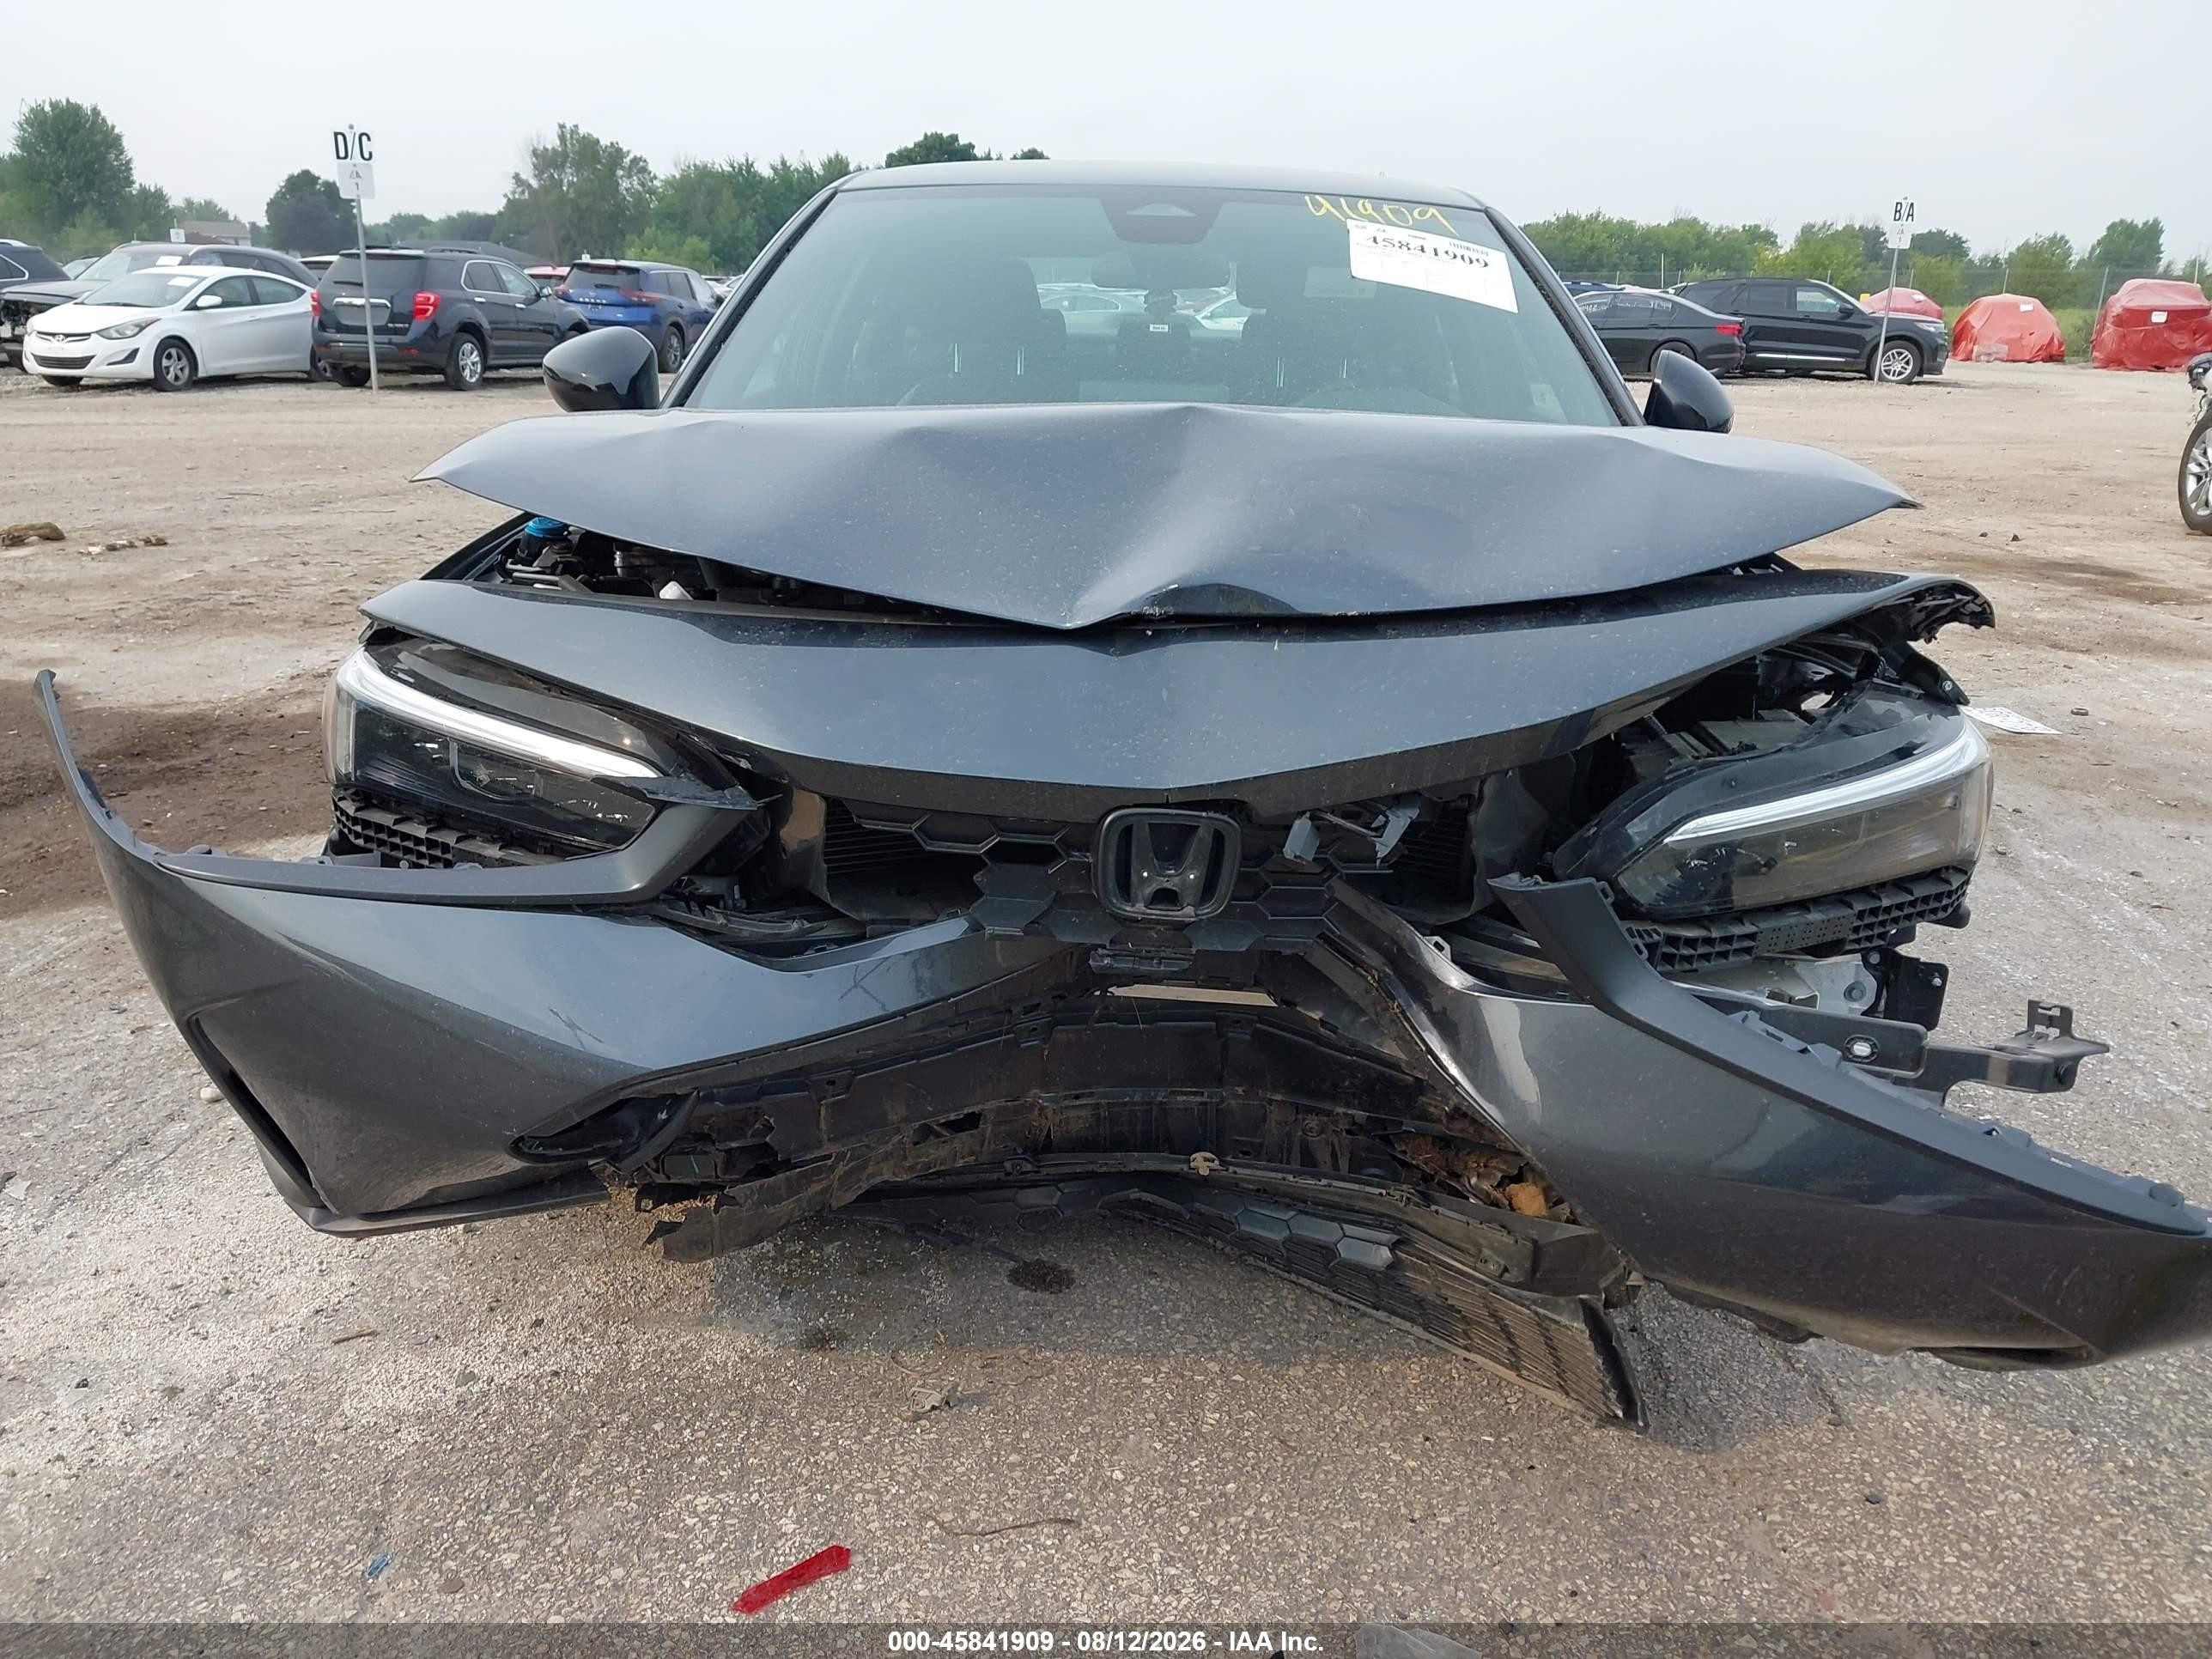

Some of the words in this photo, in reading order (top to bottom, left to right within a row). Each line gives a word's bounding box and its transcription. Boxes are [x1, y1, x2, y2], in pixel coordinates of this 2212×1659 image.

[333, 131, 373, 161] D/C
[1893, 202, 1914, 222] B/A
[1366, 234, 1490, 269] 45841909
